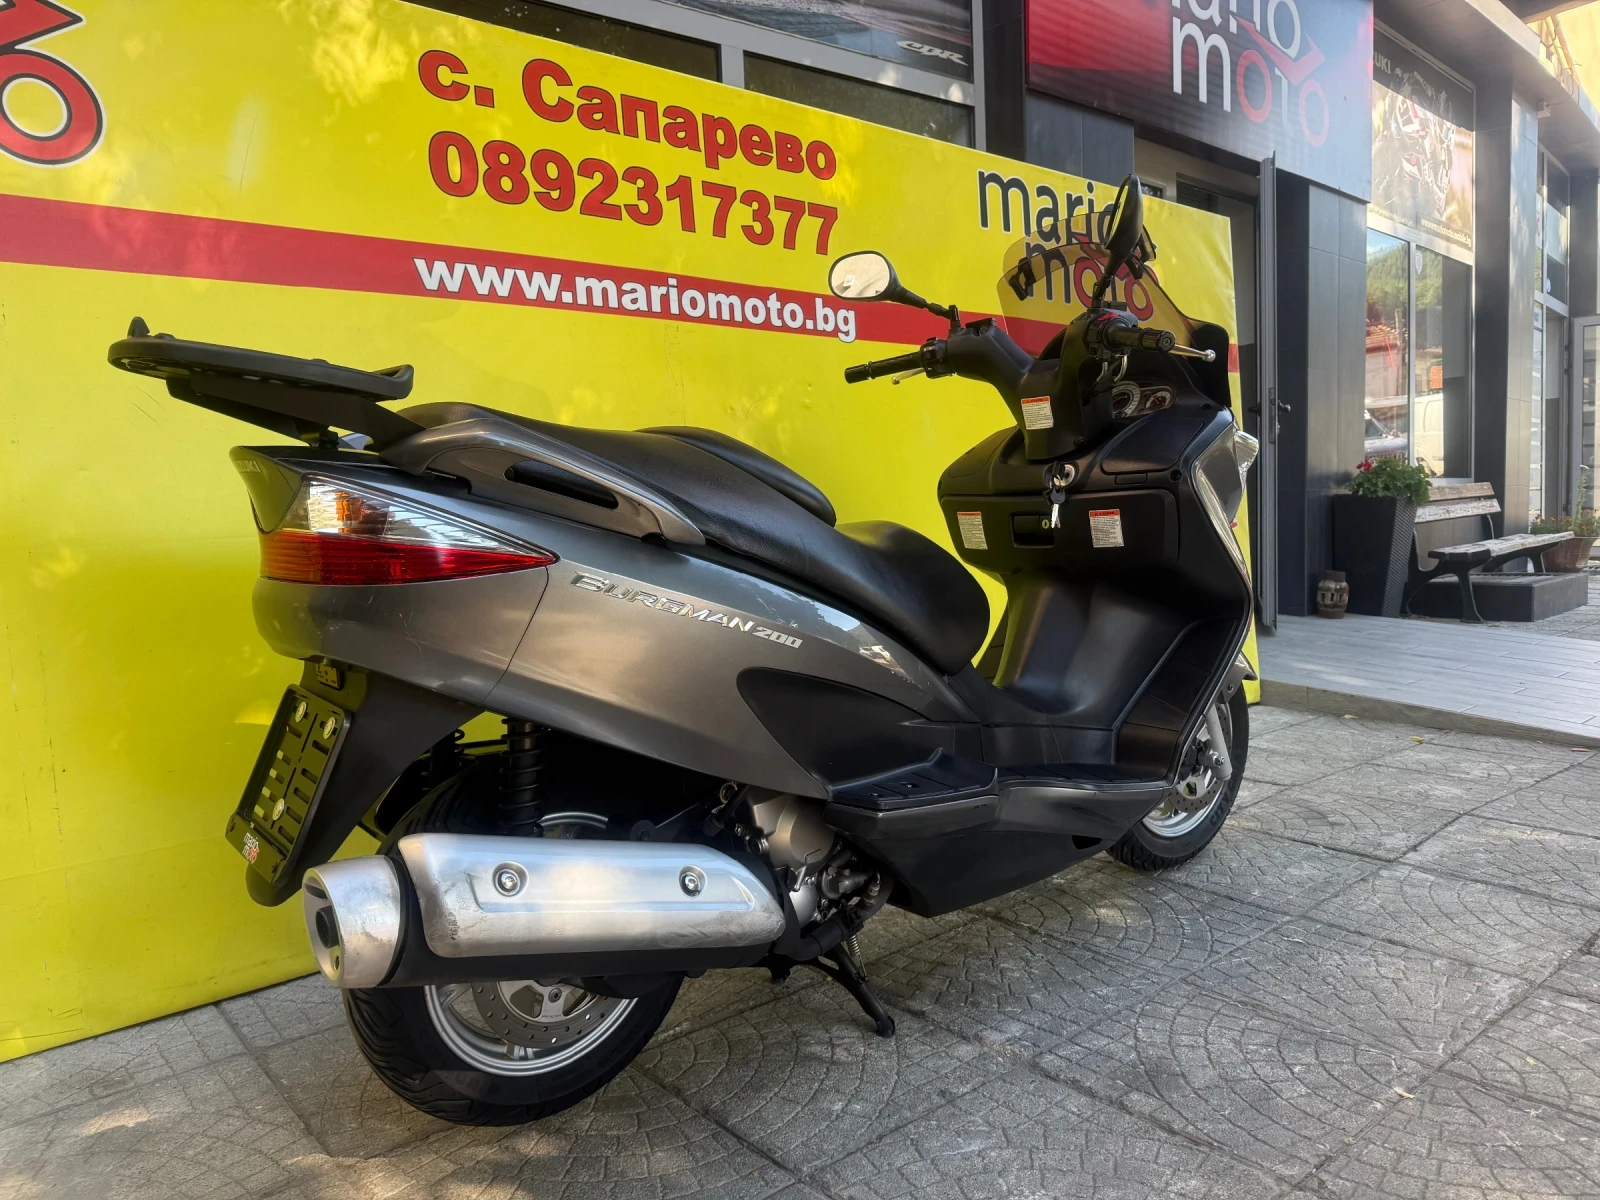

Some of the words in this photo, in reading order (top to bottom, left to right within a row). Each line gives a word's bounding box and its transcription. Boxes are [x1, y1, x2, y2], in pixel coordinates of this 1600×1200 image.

[896, 41, 970, 67] CBR
[1172, 16, 1330, 147] moto
[1373, 51, 1391, 75] UKI
[418, 49, 495, 108] с.
[521, 58, 837, 181] Сапарево
[428, 131, 839, 256] 0892317377
[412, 257, 857, 344] www.mariomoto.bg
[570, 570, 756, 633] BURGMAN
[752, 626, 803, 649] 200
